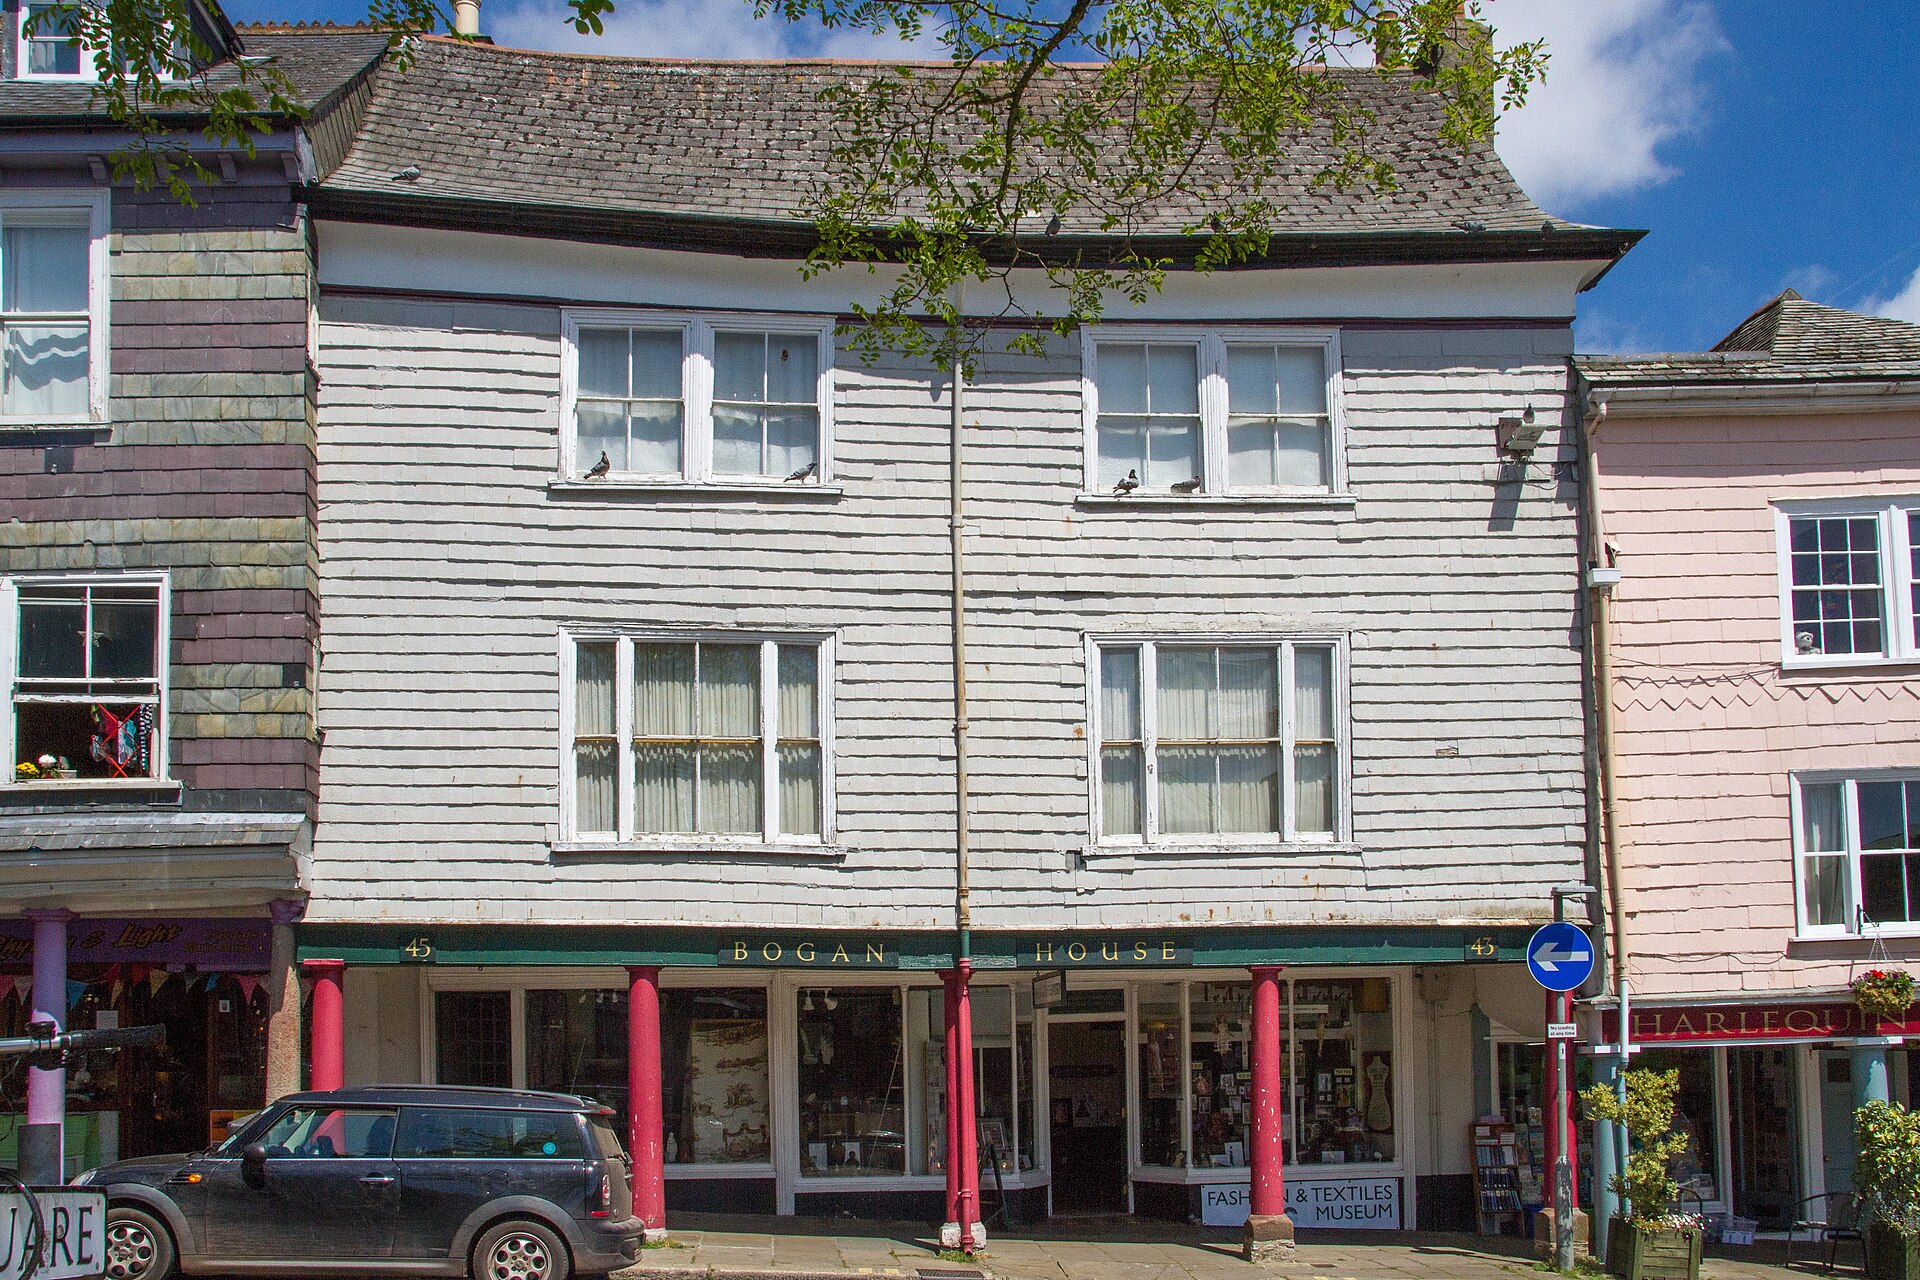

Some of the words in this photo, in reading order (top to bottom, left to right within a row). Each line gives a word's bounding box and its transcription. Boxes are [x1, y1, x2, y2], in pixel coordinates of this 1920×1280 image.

[111, 922, 182, 949] Light
[1471, 936, 1495, 956] 43
[405, 937, 431, 958] 45
[734, 941, 884, 963] BOGAN
[1035, 941, 1176, 962] HOUSE
[1633, 1009, 1906, 1037] HARLEQUIN
[1296, 1188, 1308, 1203] &
[1311, 1185, 1392, 1203] TEXTILES
[1316, 1203, 1393, 1221] MUSEUM
